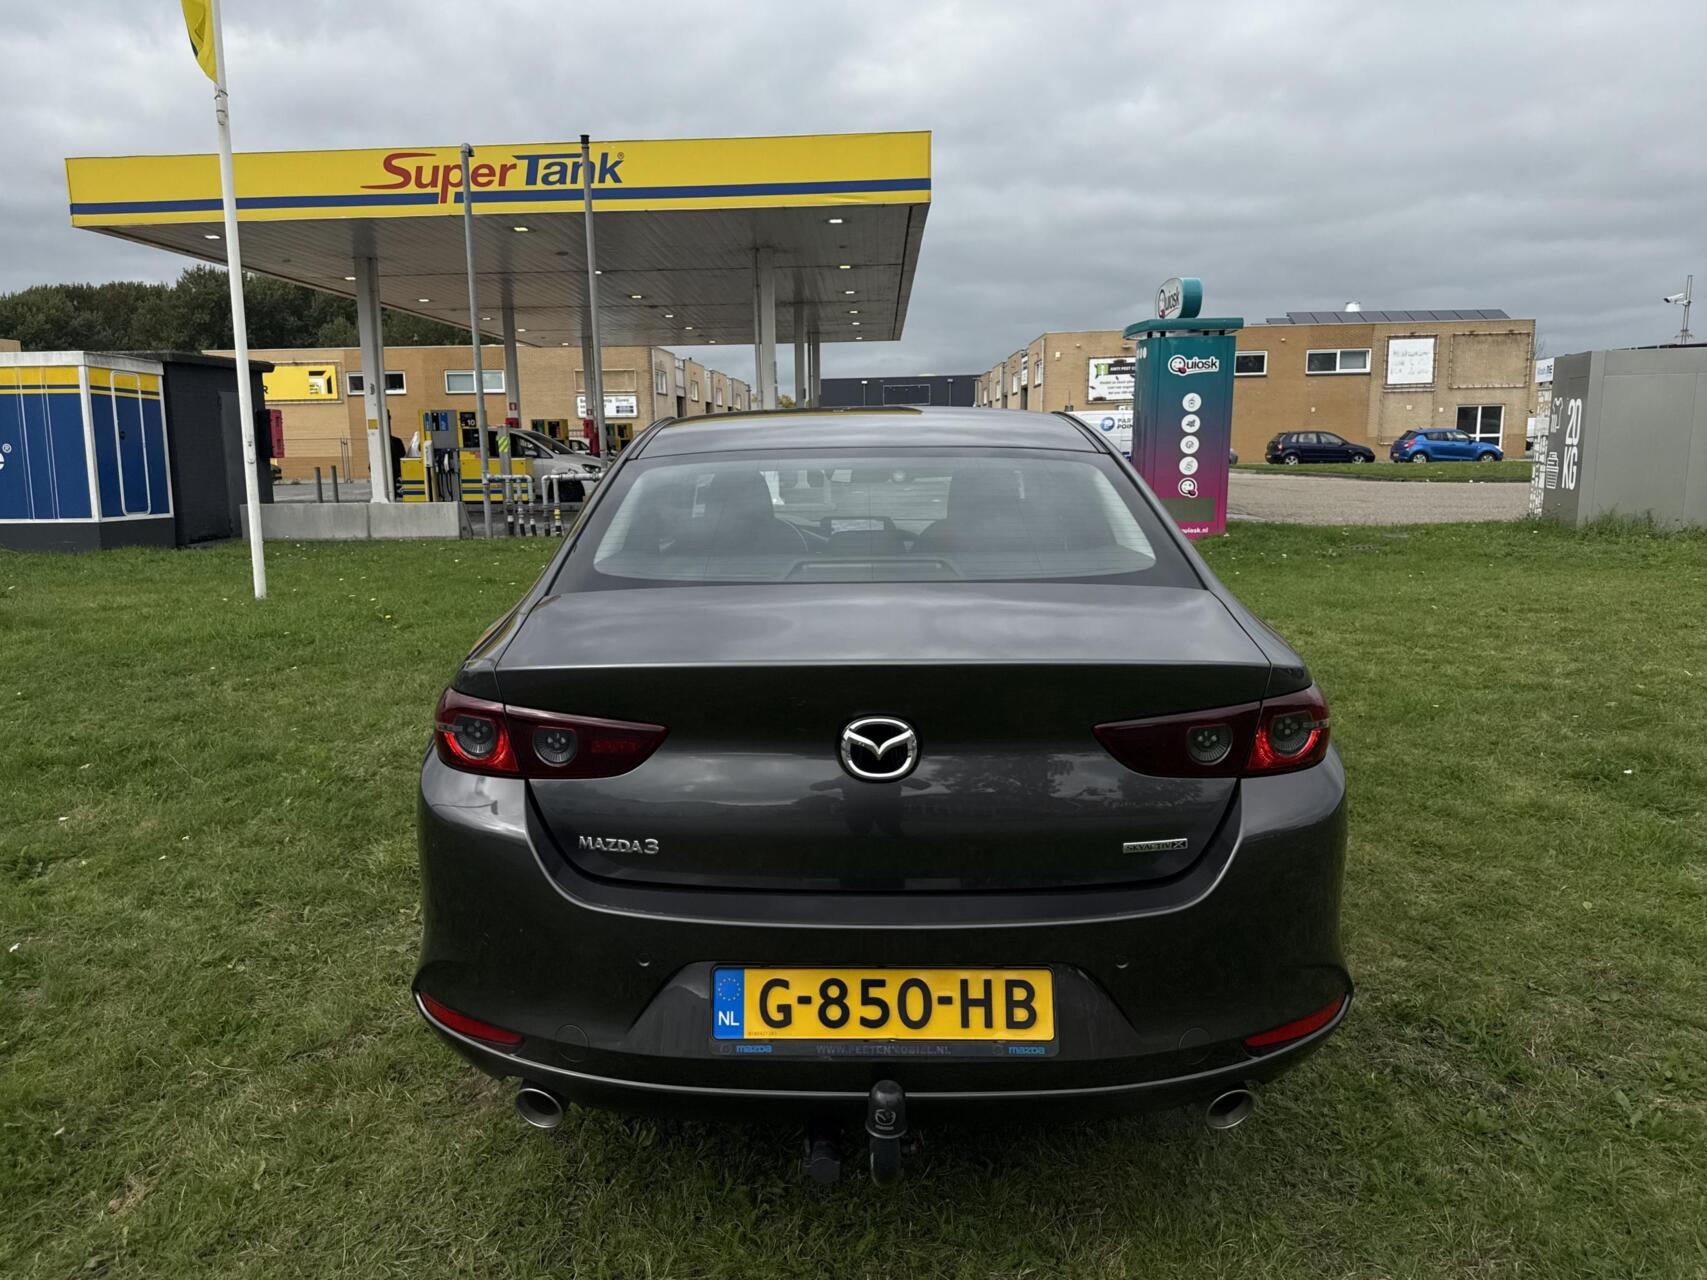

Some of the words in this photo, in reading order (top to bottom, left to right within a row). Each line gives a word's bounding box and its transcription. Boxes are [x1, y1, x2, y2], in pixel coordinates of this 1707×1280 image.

[1158, 286, 1180, 318] Quiosk
[1169, 355, 1218, 374] Quiosk
[1565, 398, 1582, 445] 20
[1561, 446, 1578, 490] KG
[717, 1011, 740, 1027] NL
[758, 978, 1037, 1030] G-850-HB
